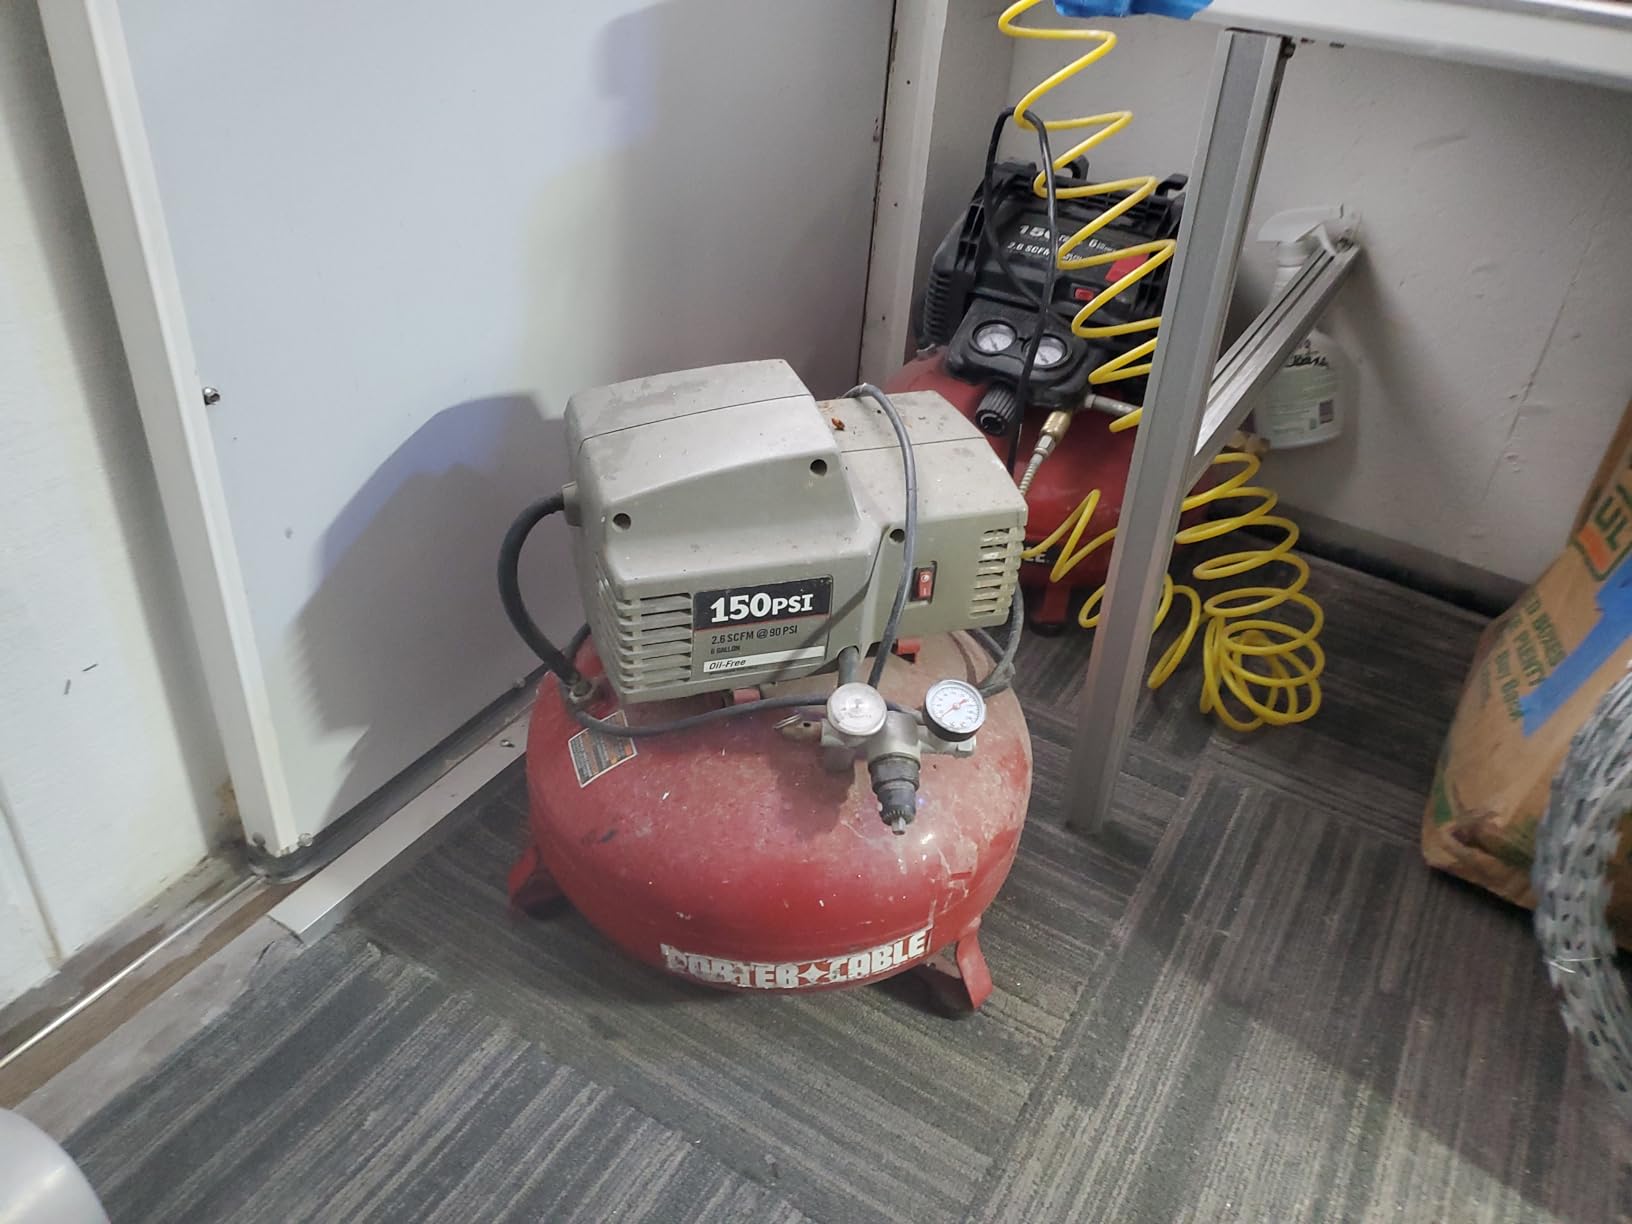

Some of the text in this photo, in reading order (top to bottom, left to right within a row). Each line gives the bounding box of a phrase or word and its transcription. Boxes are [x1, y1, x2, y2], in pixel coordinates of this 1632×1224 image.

[710, 592, 814, 623] 150PSI
[711, 625, 798, 645] 2.6 SCFM @ 90 PSI
[709, 659, 747, 670] Oil-Free
